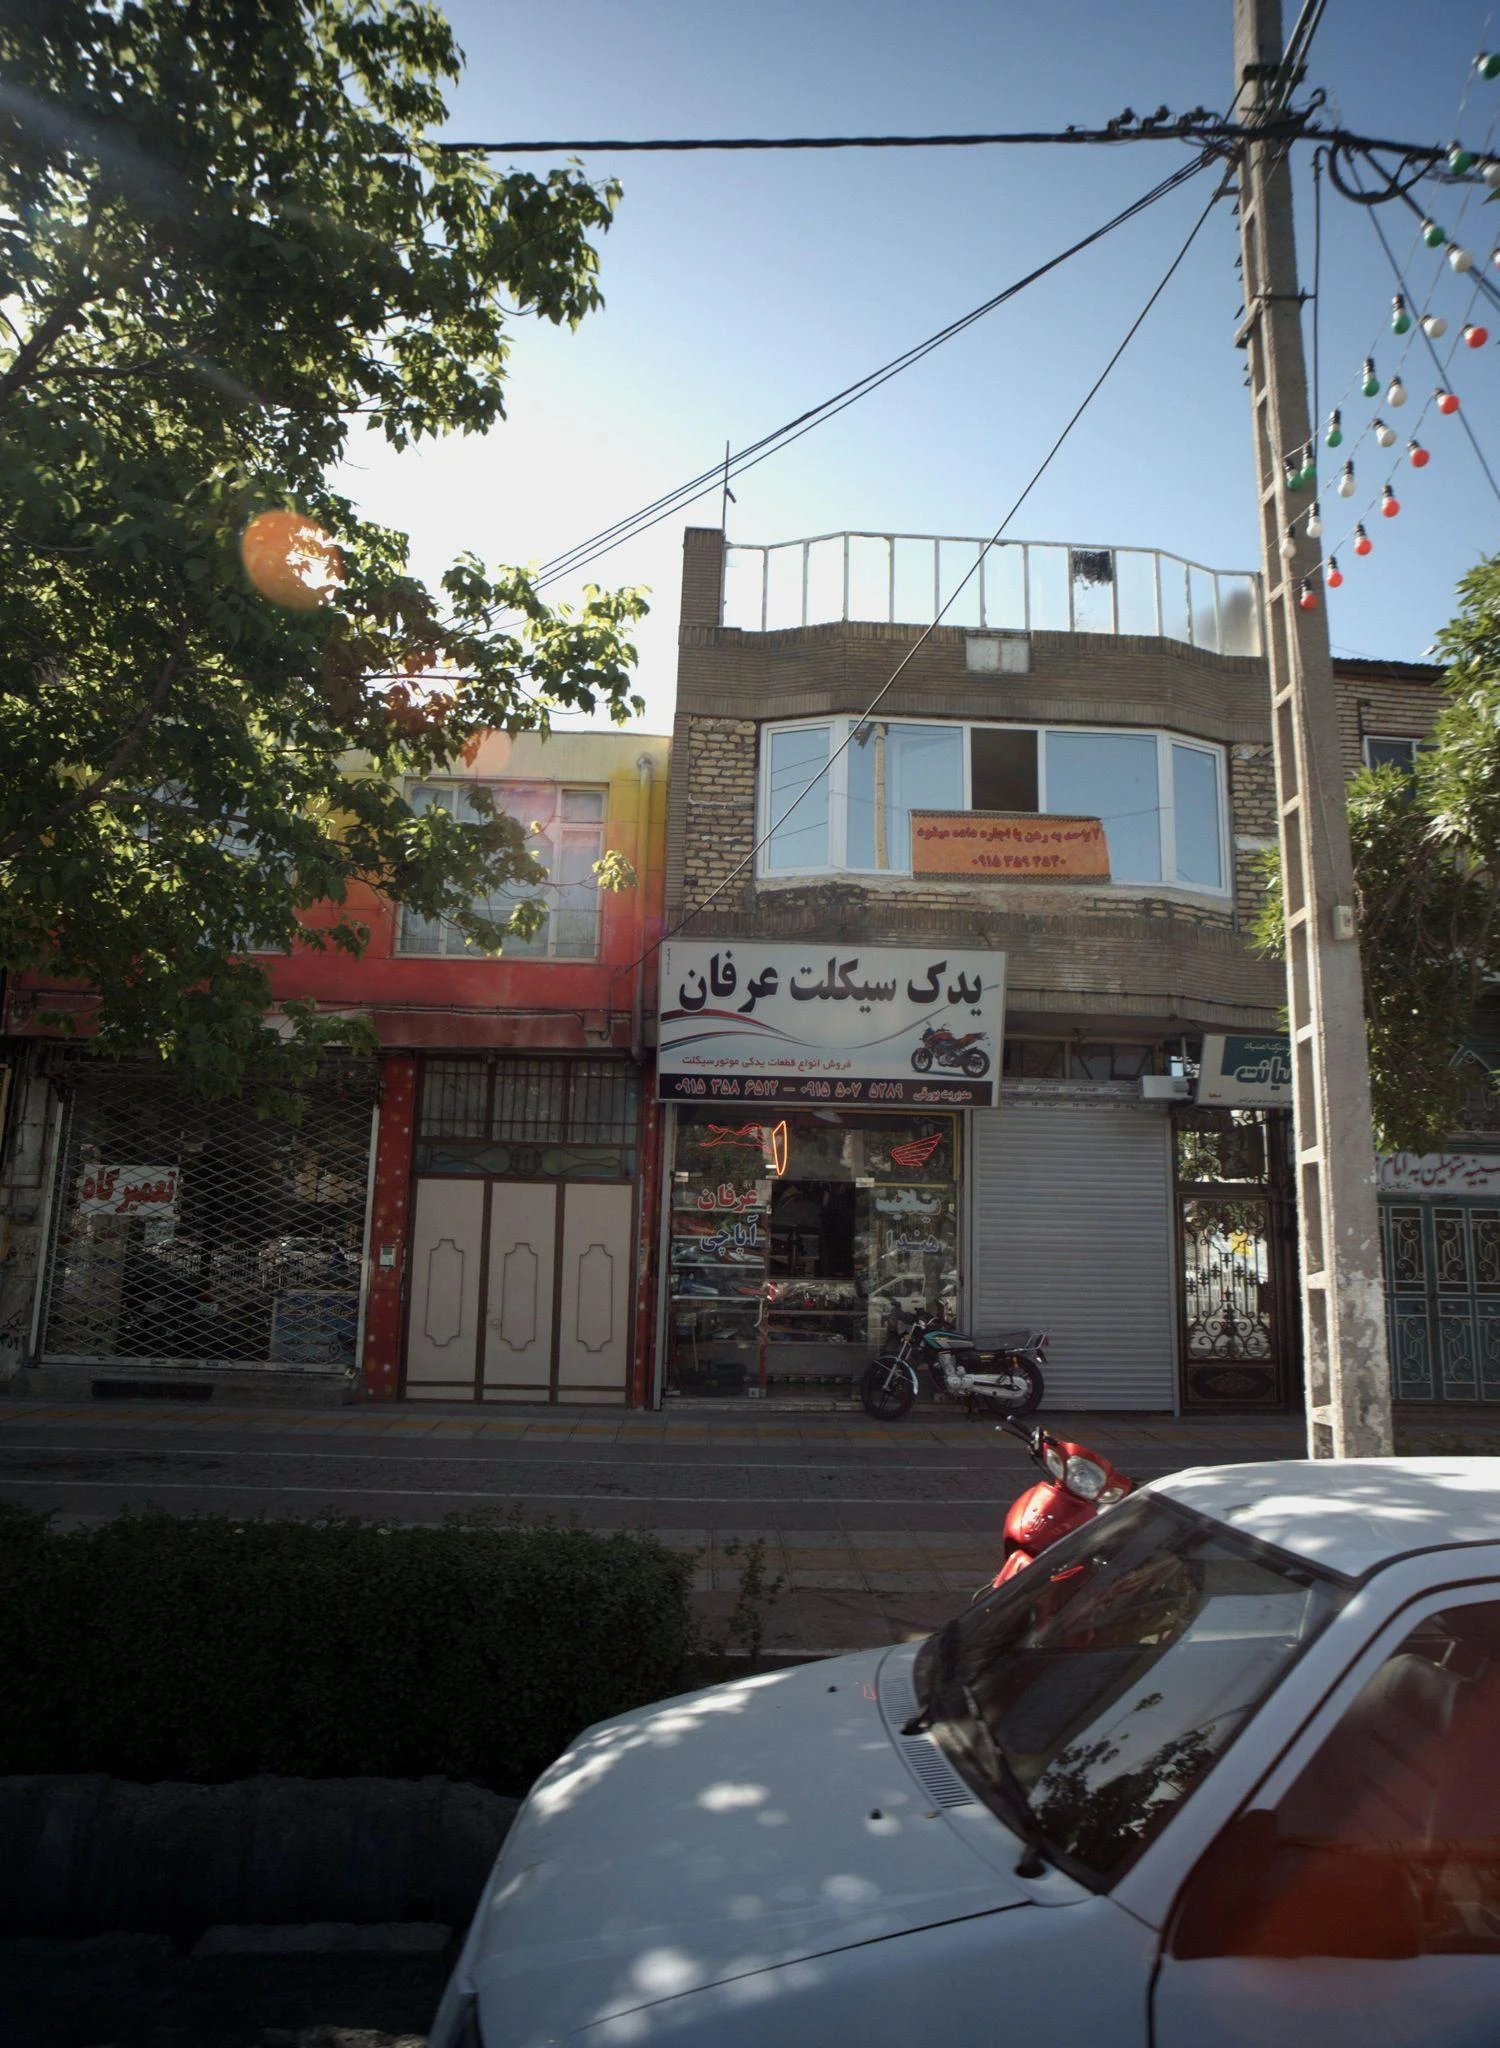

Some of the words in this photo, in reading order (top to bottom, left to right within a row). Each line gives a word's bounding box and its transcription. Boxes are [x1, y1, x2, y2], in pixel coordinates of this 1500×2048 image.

[979, 826, 1011, 842] اجاره
[1012, 827, 1022, 842] یا
[1024, 830, 1049, 843] رهن
[1050, 831, 1063, 843] به
[678, 949, 779, 1014] عرفان
[789, 956, 897, 1014] سیکلت
[906, 960, 983, 1017] یدک
[741, 1057, 765, 1068] یدکی
[767, 1057, 796, 1068] قطعات
[797, 1058, 820, 1072] انواع
[823, 1058, 852, 1070] فروش
[675, 1077, 706, 1095] ۰۹۱۵
[711, 1078, 740, 1096] ۳۵۸
[800, 1081, 831, 1098] ۰۹۱۵
[835, 1081, 862, 1098] ۵۰۷
[940, 1089, 973, 1102] مدیریت
[697, 1182, 759, 1213] عرفان
[700, 1214, 759, 1256] آپاچی
[886, 1229, 940, 1253] هندا
